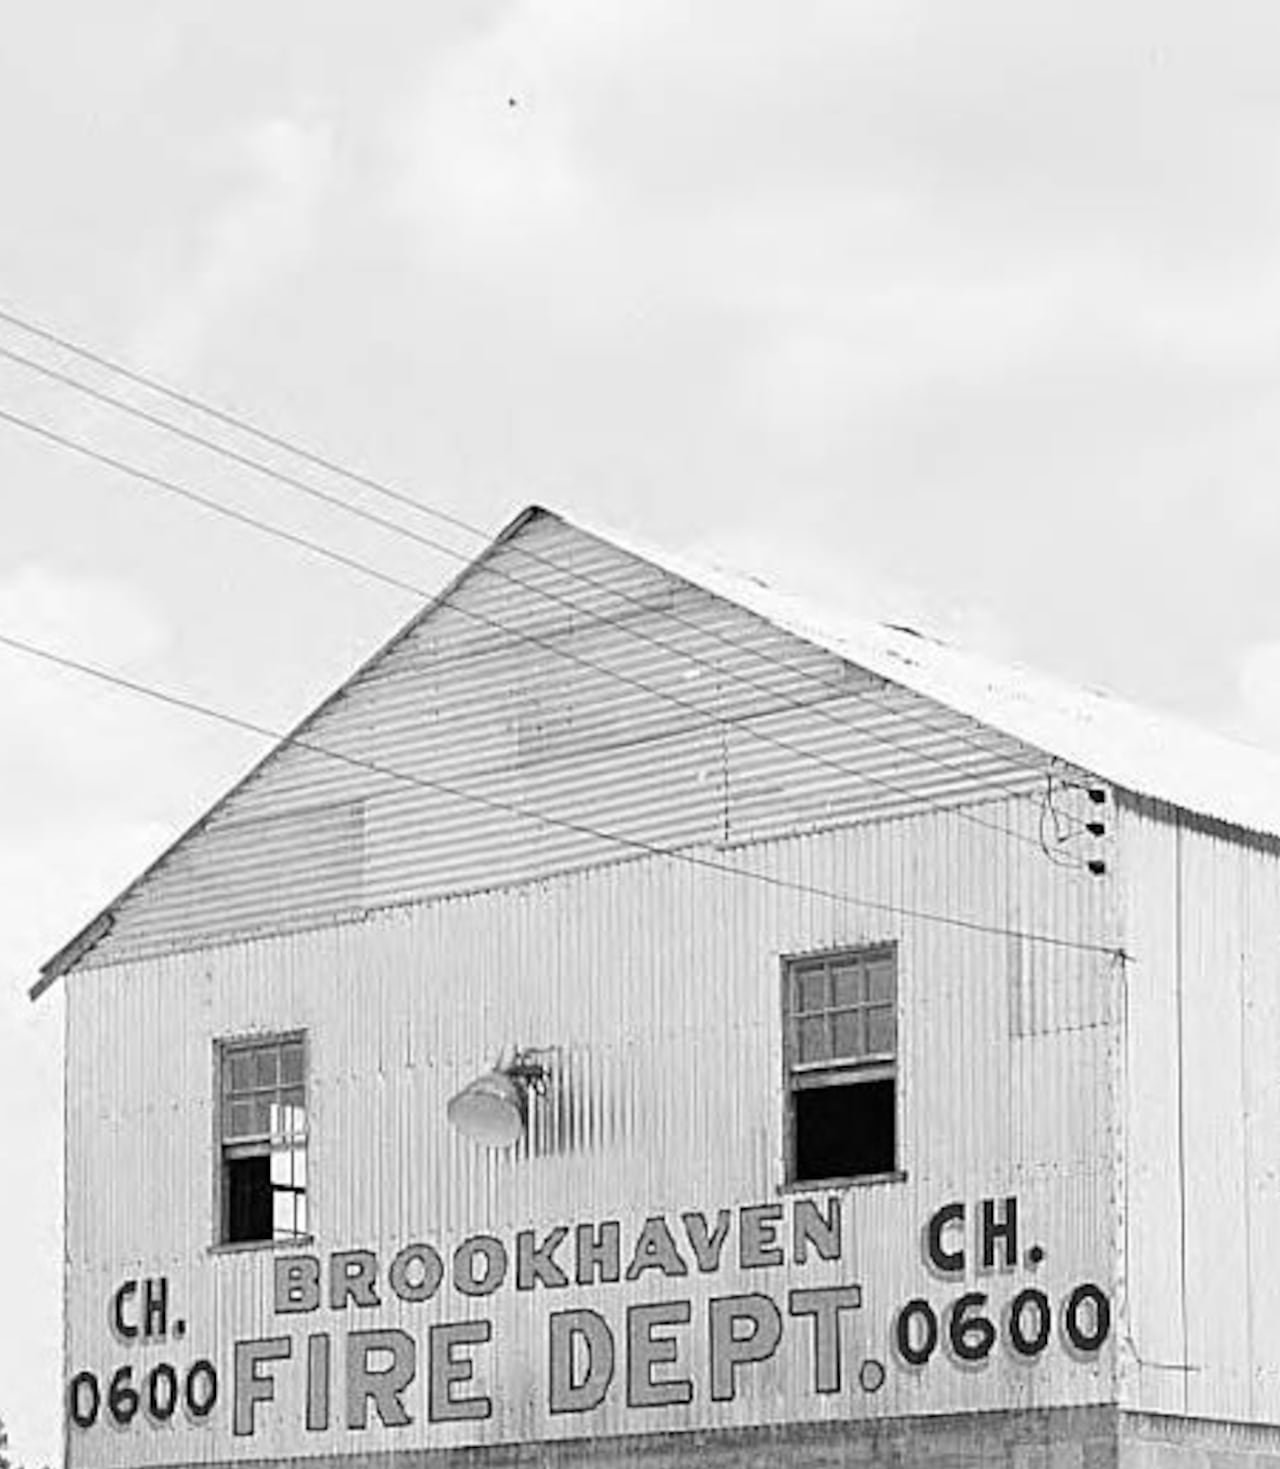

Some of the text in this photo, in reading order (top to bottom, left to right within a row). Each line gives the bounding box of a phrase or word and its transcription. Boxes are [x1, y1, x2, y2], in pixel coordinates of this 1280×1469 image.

[274, 1196, 842, 1314] BROOKHAVEN
[927, 1196, 1045, 1273] CH.
[114, 1277, 185, 1338] CH.
[897, 1283, 1111, 1366] 0600
[71, 1359, 217, 1429] 0600
[233, 1284, 886, 1436] FIRE DEPT.
